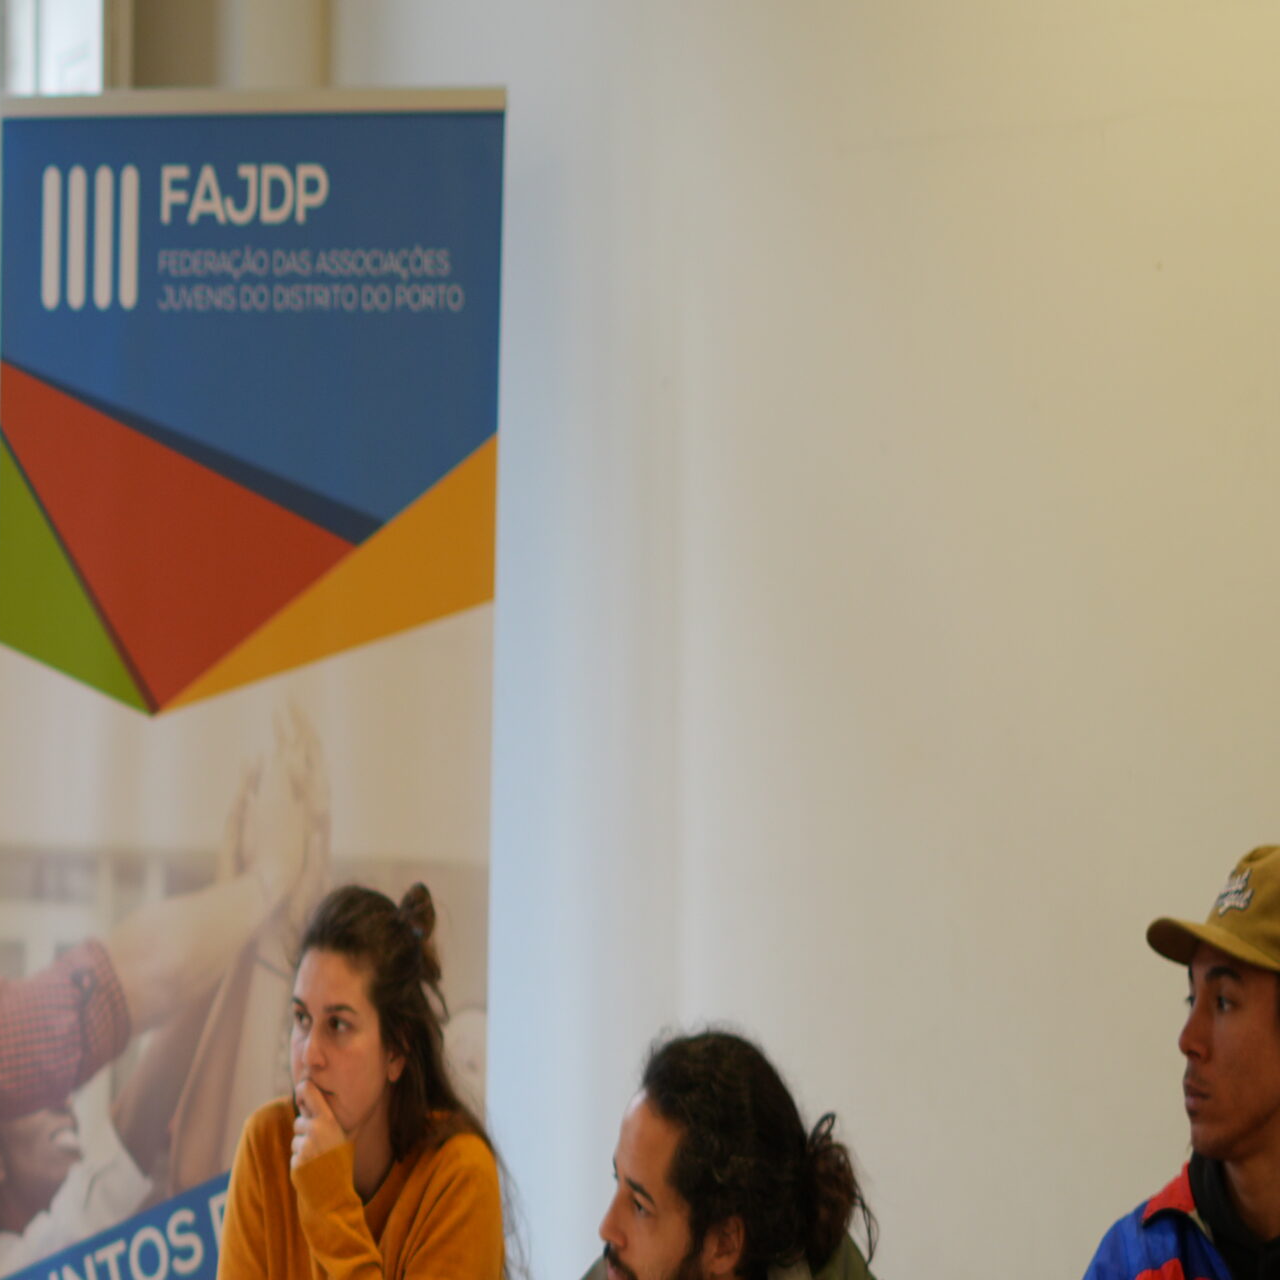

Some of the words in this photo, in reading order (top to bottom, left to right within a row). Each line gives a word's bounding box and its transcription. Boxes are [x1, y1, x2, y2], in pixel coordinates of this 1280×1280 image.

[159, 164, 329, 225] FAJDP
[273, 249, 311, 276] DAS
[158, 284, 236, 311] JUVENIS
[240, 284, 269, 311] DO
[273, 284, 358, 311] DISTRITO
[361, 284, 393, 311] DO
[395, 284, 465, 311] PORTO
